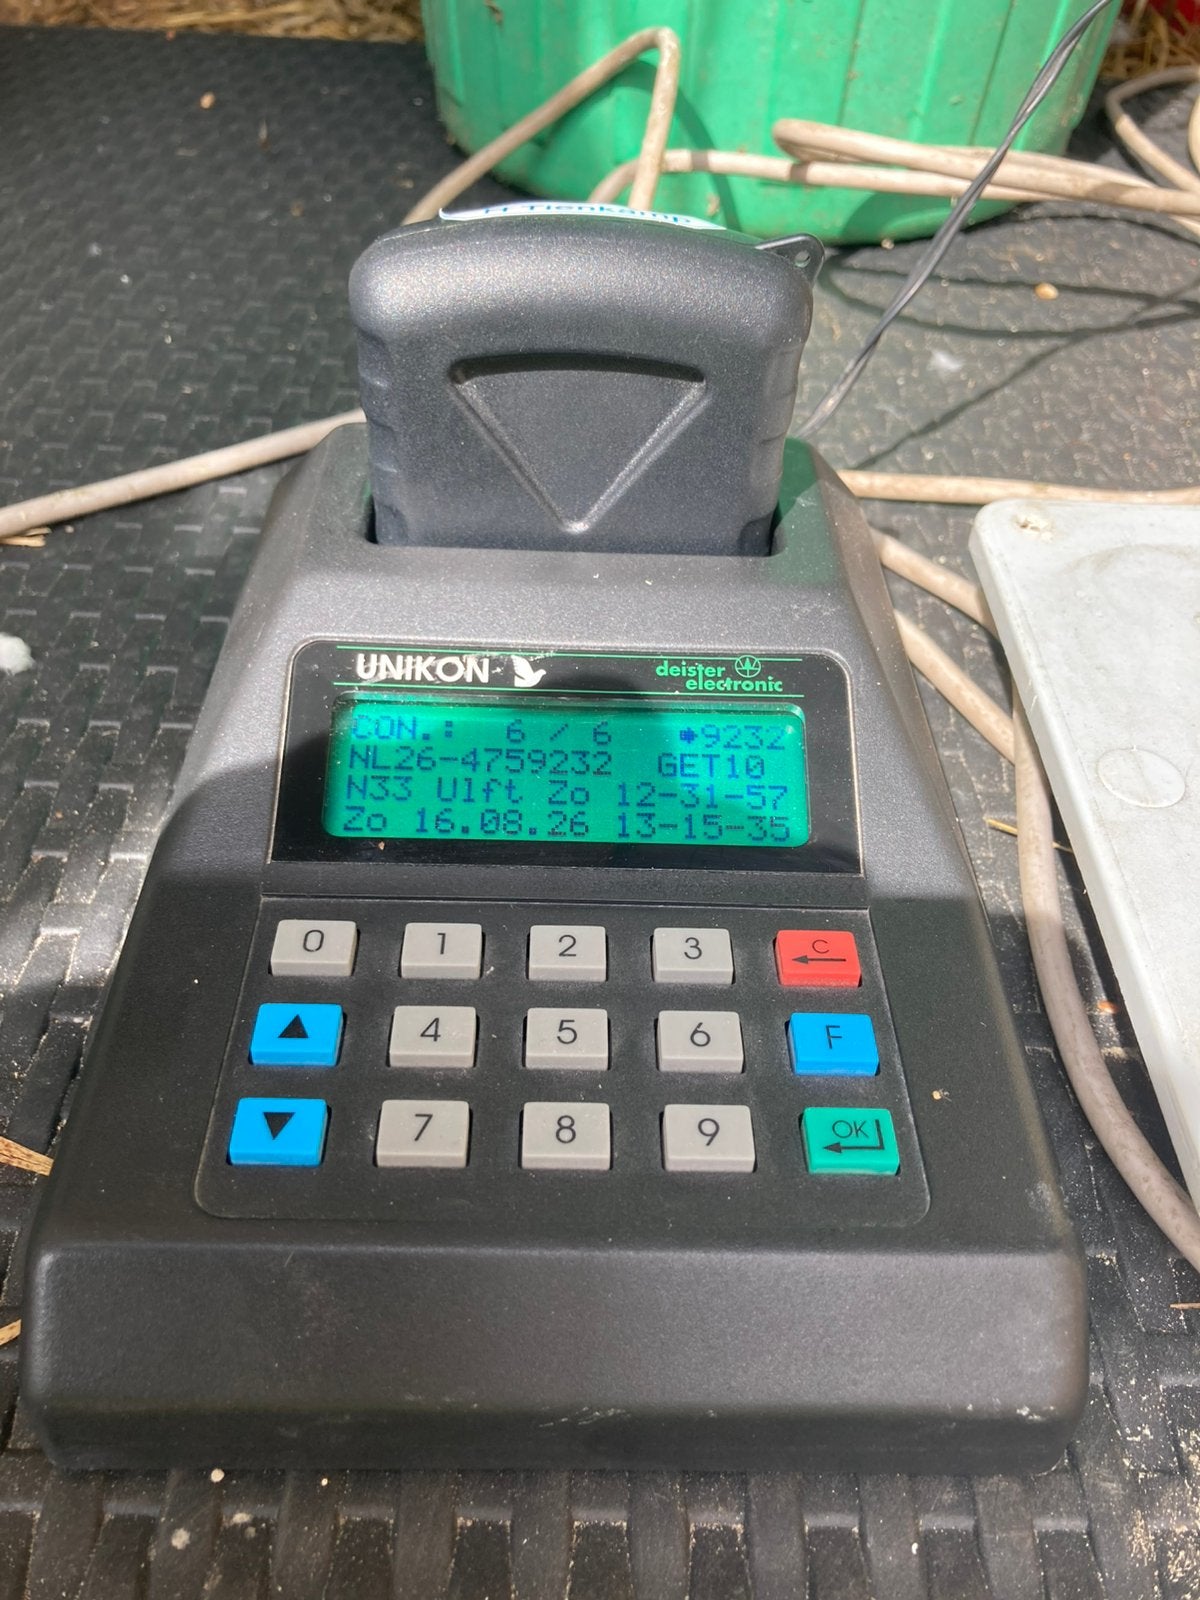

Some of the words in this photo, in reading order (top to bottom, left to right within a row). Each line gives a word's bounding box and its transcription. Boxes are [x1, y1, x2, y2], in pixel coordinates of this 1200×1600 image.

[355, 653, 489, 683] UNIKON
[655, 660, 726, 678] deister
[685, 676, 784, 692] electronic
[506, 718, 526, 744] 6
[550, 723, 569, 742] /
[592, 721, 612, 746] 6
[701, 724, 786, 751] 9232
[349, 744, 613, 777] NL26-4759232
[657, 752, 765, 780] GET10
[346, 774, 413, 801] N33
[437, 776, 524, 804] Ulft
[547, 780, 590, 806] Zo
[617, 782, 788, 811] 12-31-57
[343, 805, 388, 832] Zo
[416, 806, 589, 837] 16.08.26
[617, 811, 791, 843] 13-15-35
[302, 930, 325, 953] 0
[437, 932, 446, 954] 1
[558, 934, 577, 957] 2
[684, 936, 703, 960] 3
[811, 939, 829, 954] C
[420, 1017, 441, 1042] 4
[556, 1019, 577, 1044] 5
[690, 1022, 711, 1047] 6
[826, 1025, 843, 1050] F
[414, 1113, 433, 1142] 7
[556, 1115, 577, 1144] 8
[698, 1117, 720, 1147] 9
[832, 1120, 867, 1139] OK
